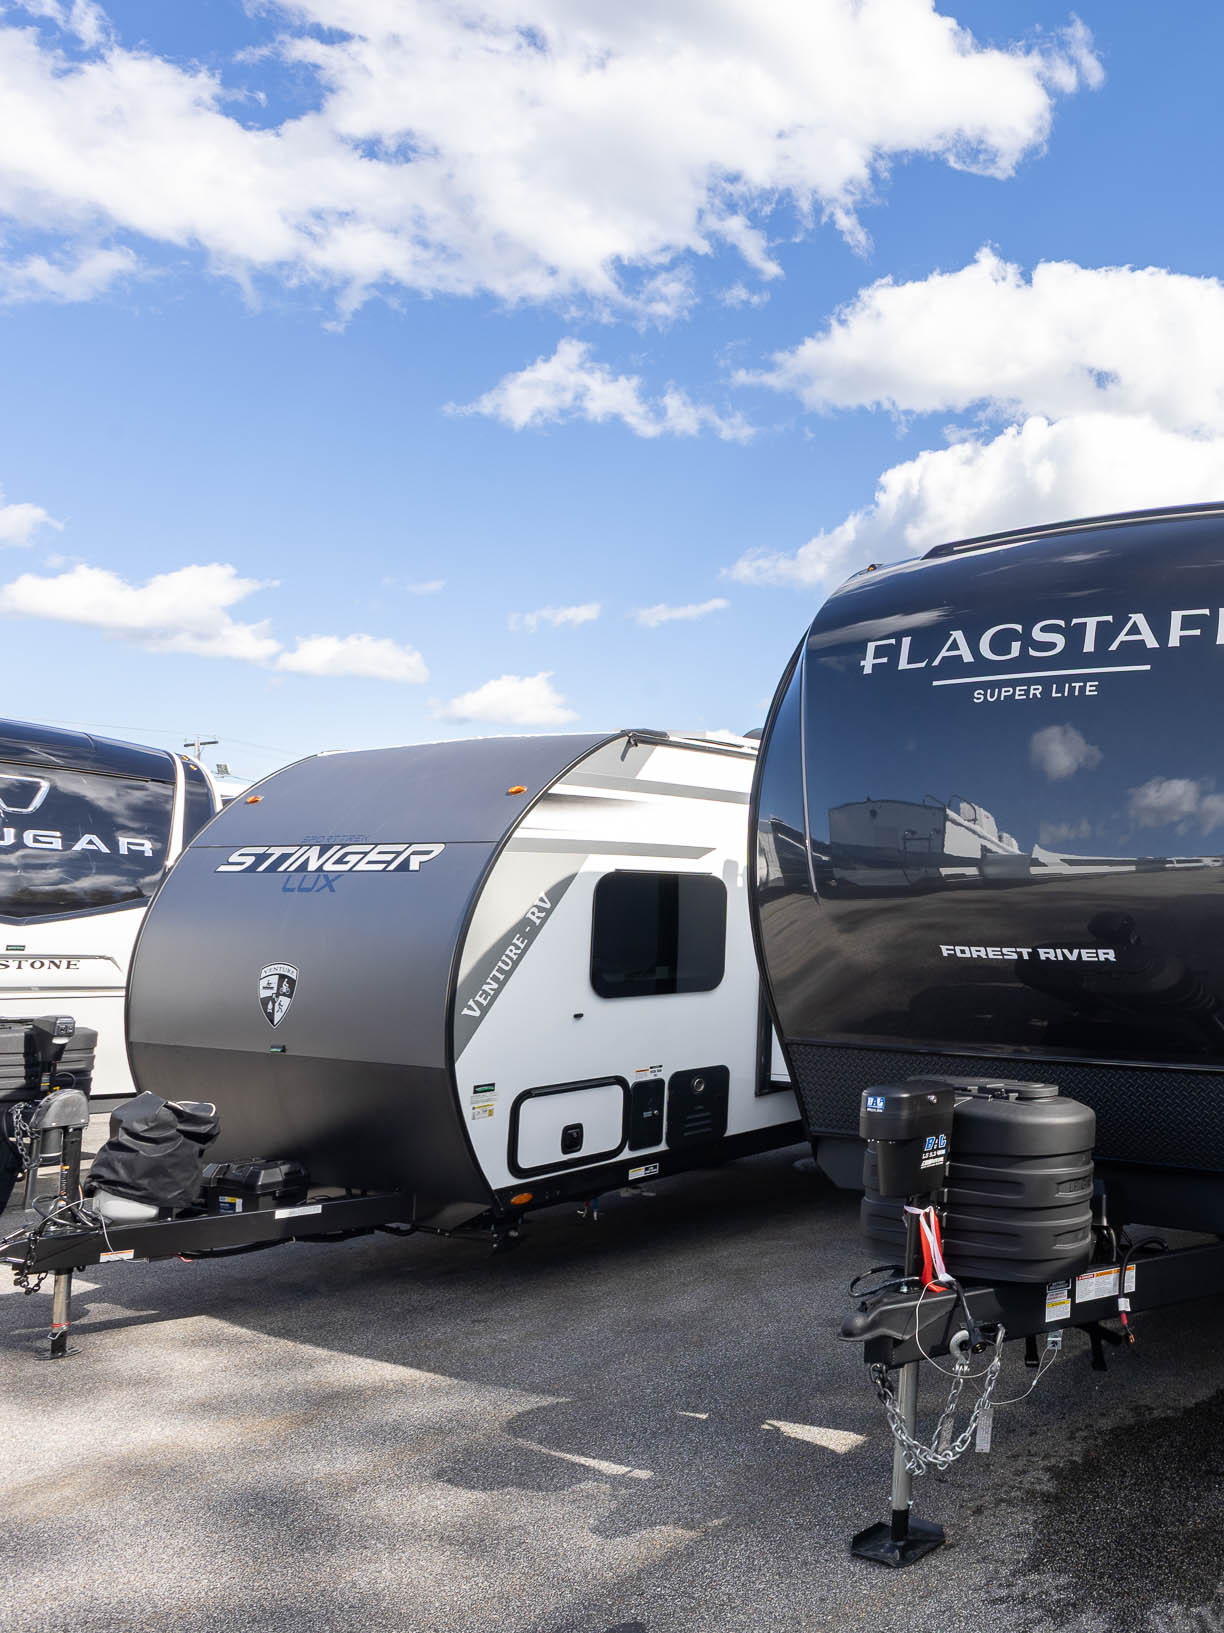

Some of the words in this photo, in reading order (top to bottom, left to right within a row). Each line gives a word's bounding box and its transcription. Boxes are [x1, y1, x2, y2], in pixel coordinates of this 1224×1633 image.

[973, 684, 1043, 703] SUPER
[1051, 681, 1099, 697] LITE
[214, 842, 447, 873] STINGER
[281, 873, 345, 893] LUX
[461, 934, 528, 1017] VENTURE
[525, 891, 552, 926] RV
[939, 944, 1033, 960] FOREST
[1036, 948, 1117, 962] RIVER
